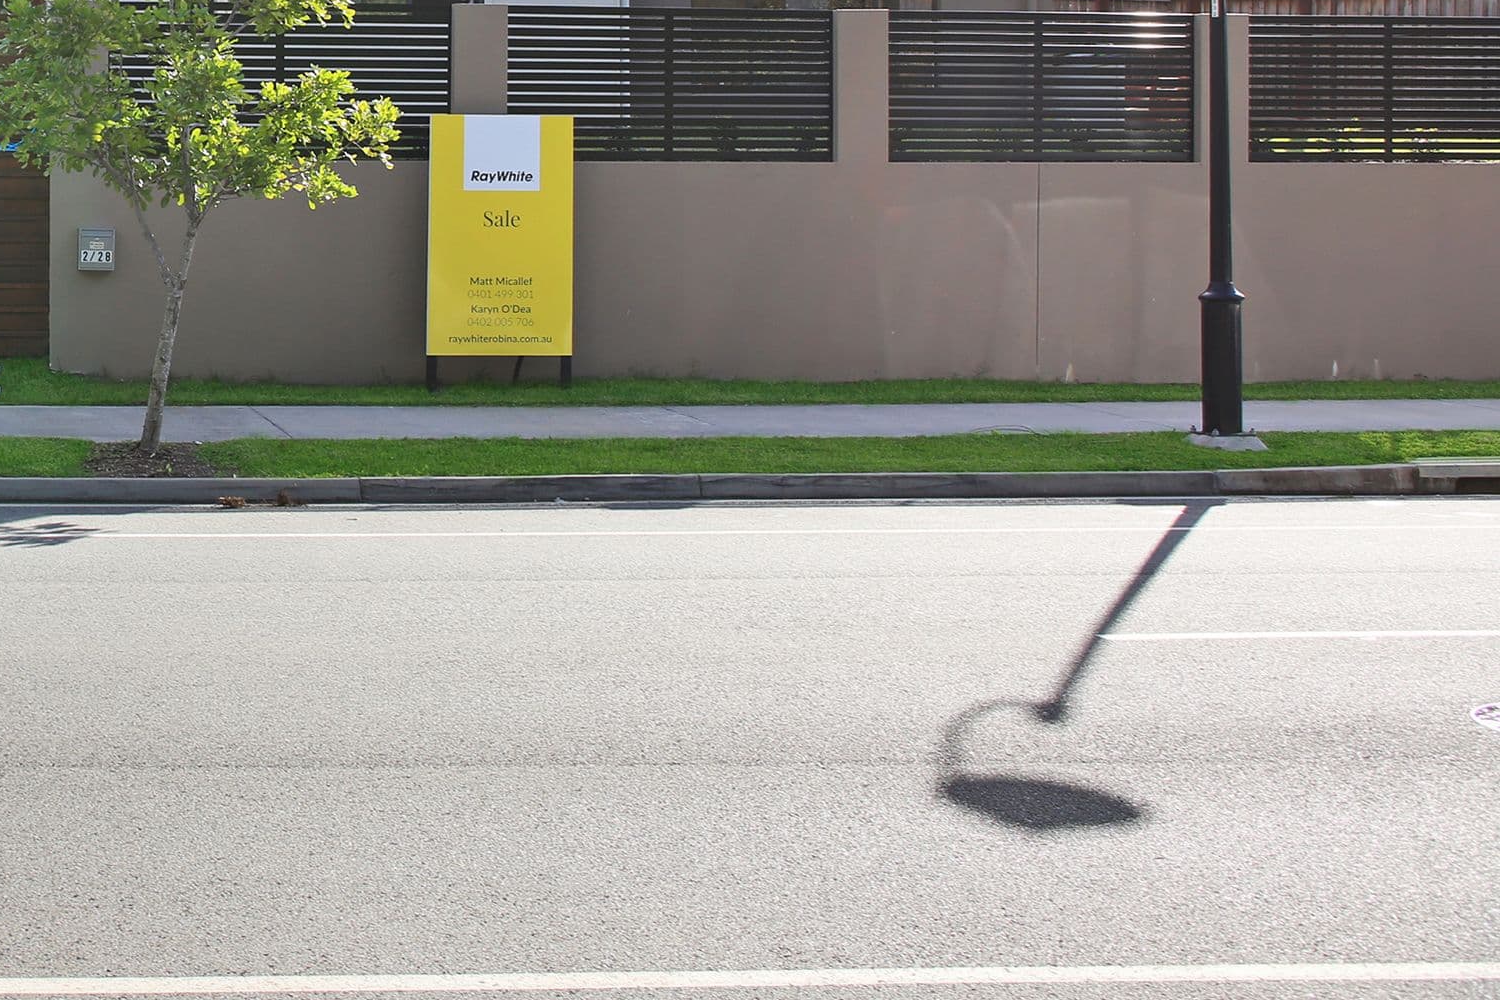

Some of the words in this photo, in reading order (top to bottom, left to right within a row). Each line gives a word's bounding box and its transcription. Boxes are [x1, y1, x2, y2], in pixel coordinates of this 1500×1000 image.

[471, 170, 533, 184] RayWhite
[483, 210, 520, 228] Sale
[83, 251, 111, 262] 2/28
[470, 276, 493, 286] Matt
[496, 276, 533, 286] Micallef
[467, 290, 492, 299] 0401
[516, 290, 534, 299] 301
[471, 304, 499, 315] Karyn
[501, 304, 532, 314] O'Dea
[449, 334, 552, 345] raywhiterobina.com.au
